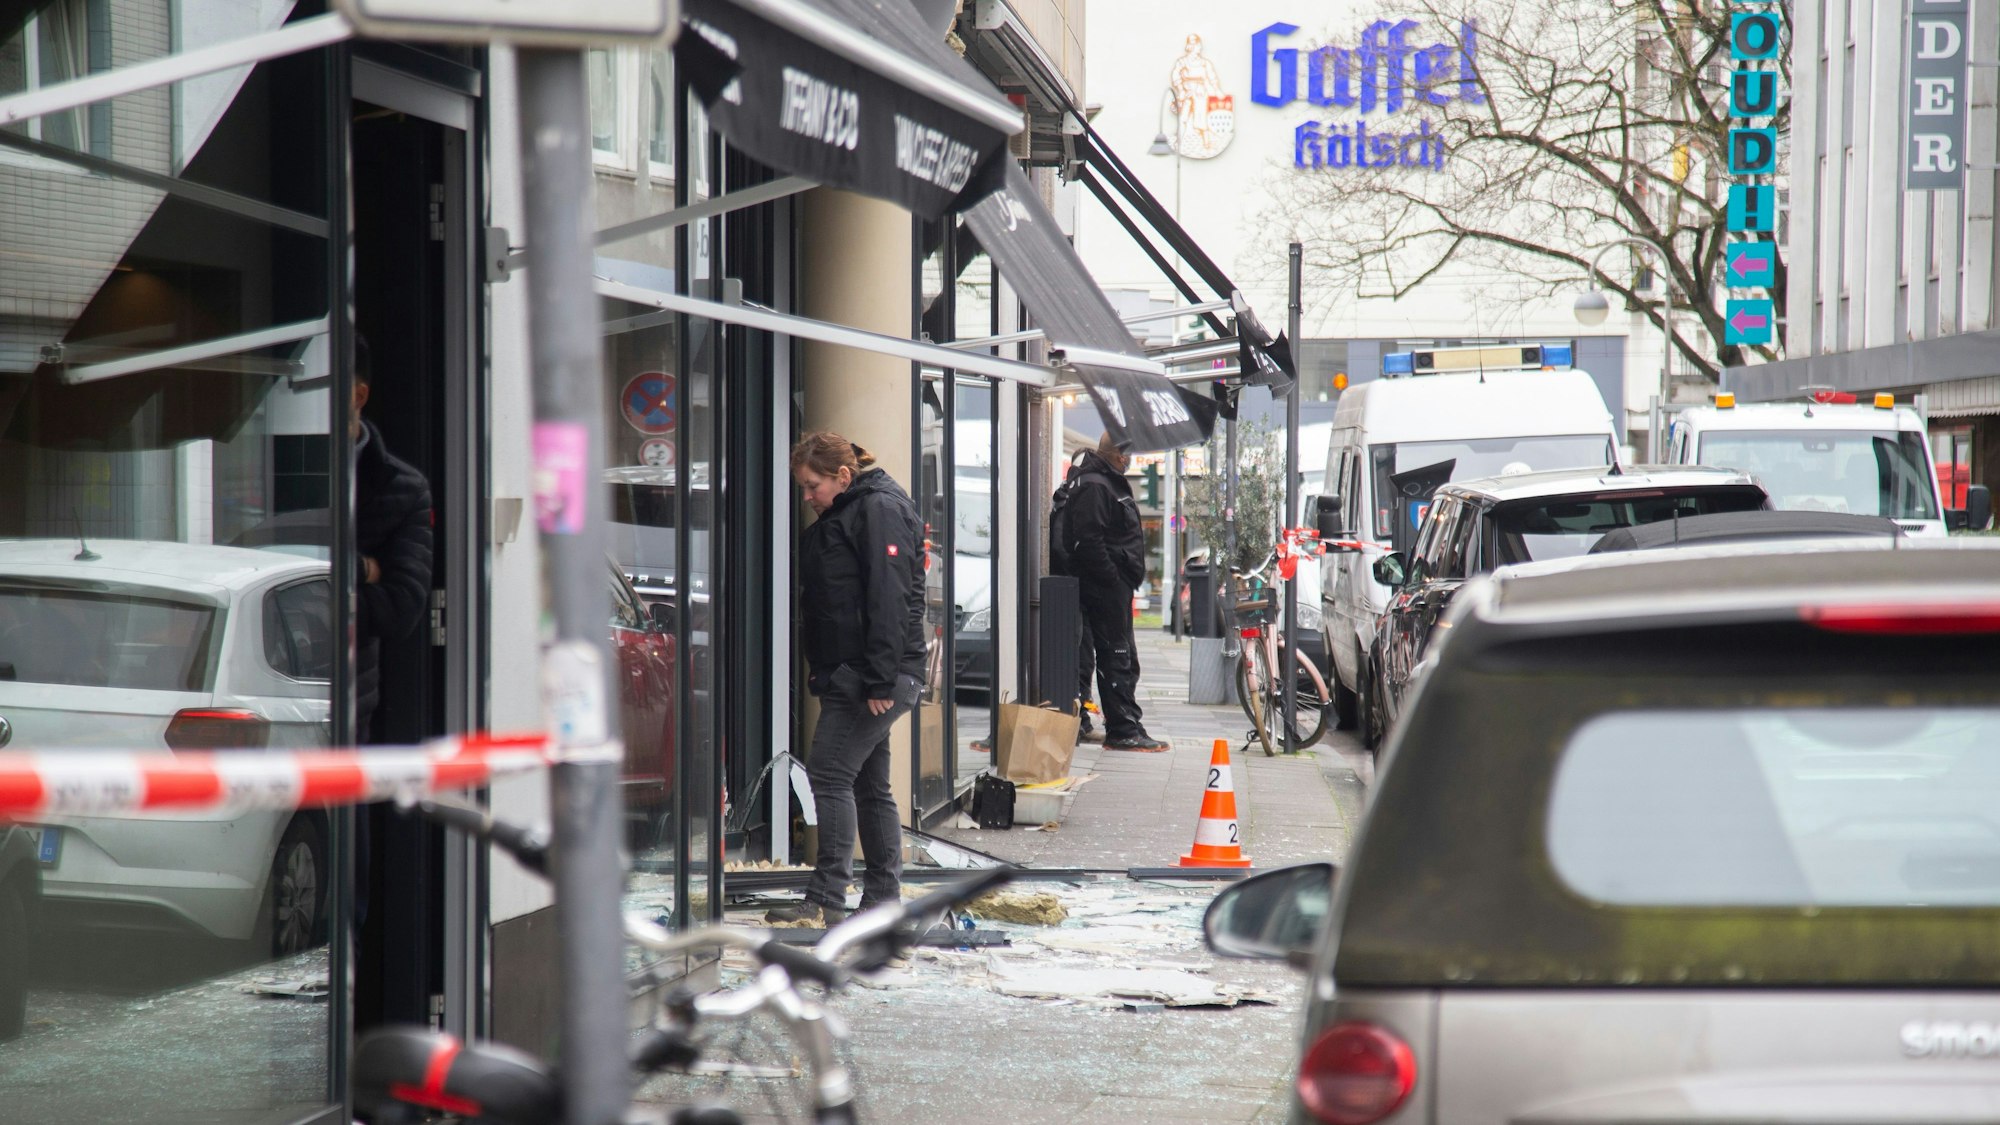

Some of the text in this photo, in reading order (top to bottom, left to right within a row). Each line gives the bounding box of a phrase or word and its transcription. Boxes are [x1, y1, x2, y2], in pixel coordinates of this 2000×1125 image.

[1251, 17, 1486, 114] Gaffel
[1912, 0, 1961, 173] DER
[1294, 118, 1444, 172] Kölsch
[1207, 768, 1221, 788] 2
[1228, 823, 1239, 844] 2
